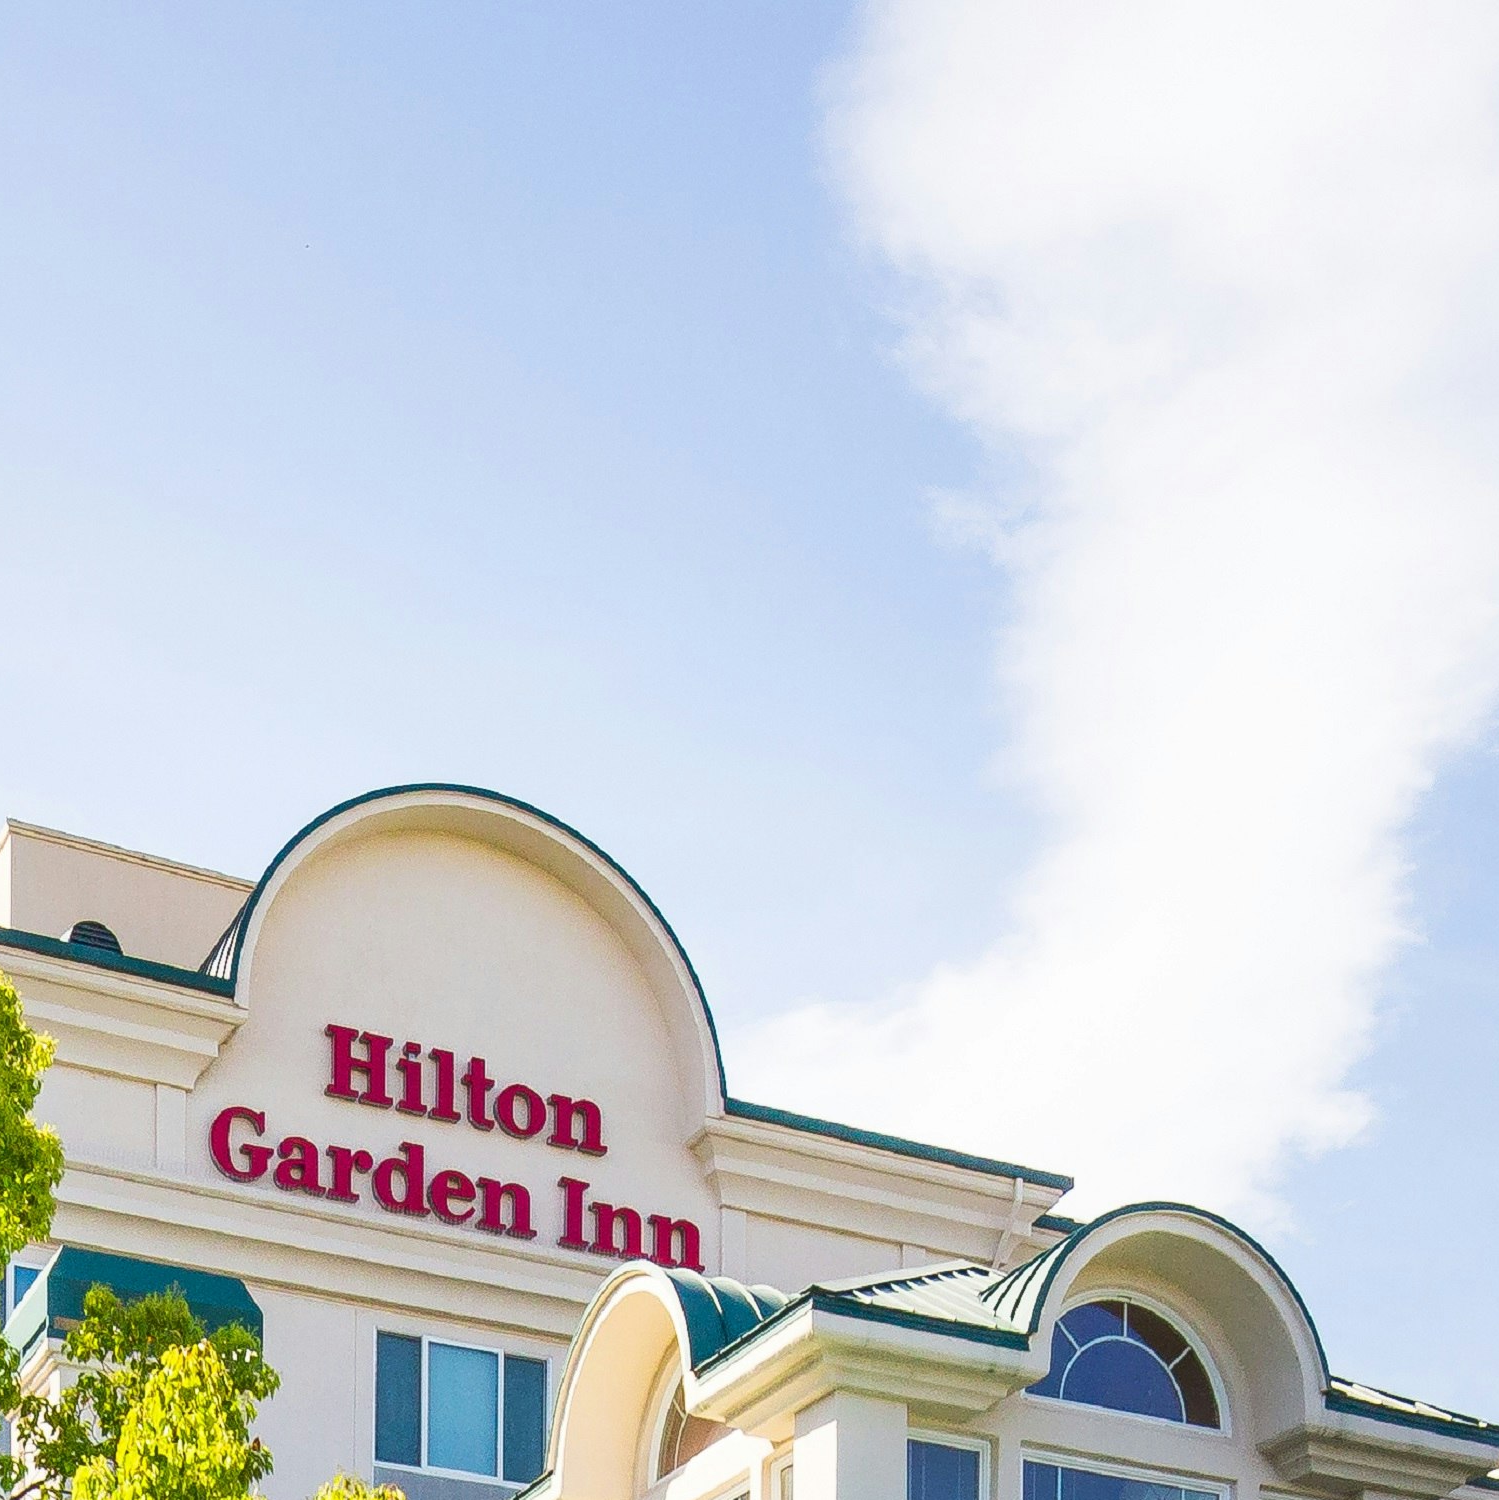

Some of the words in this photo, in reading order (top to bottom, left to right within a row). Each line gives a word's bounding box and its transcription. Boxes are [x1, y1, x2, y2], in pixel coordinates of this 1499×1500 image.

[323, 1022, 608, 1157] Hilton
[208, 1105, 537, 1240] Garden
[556, 1175, 706, 1273] Inn
